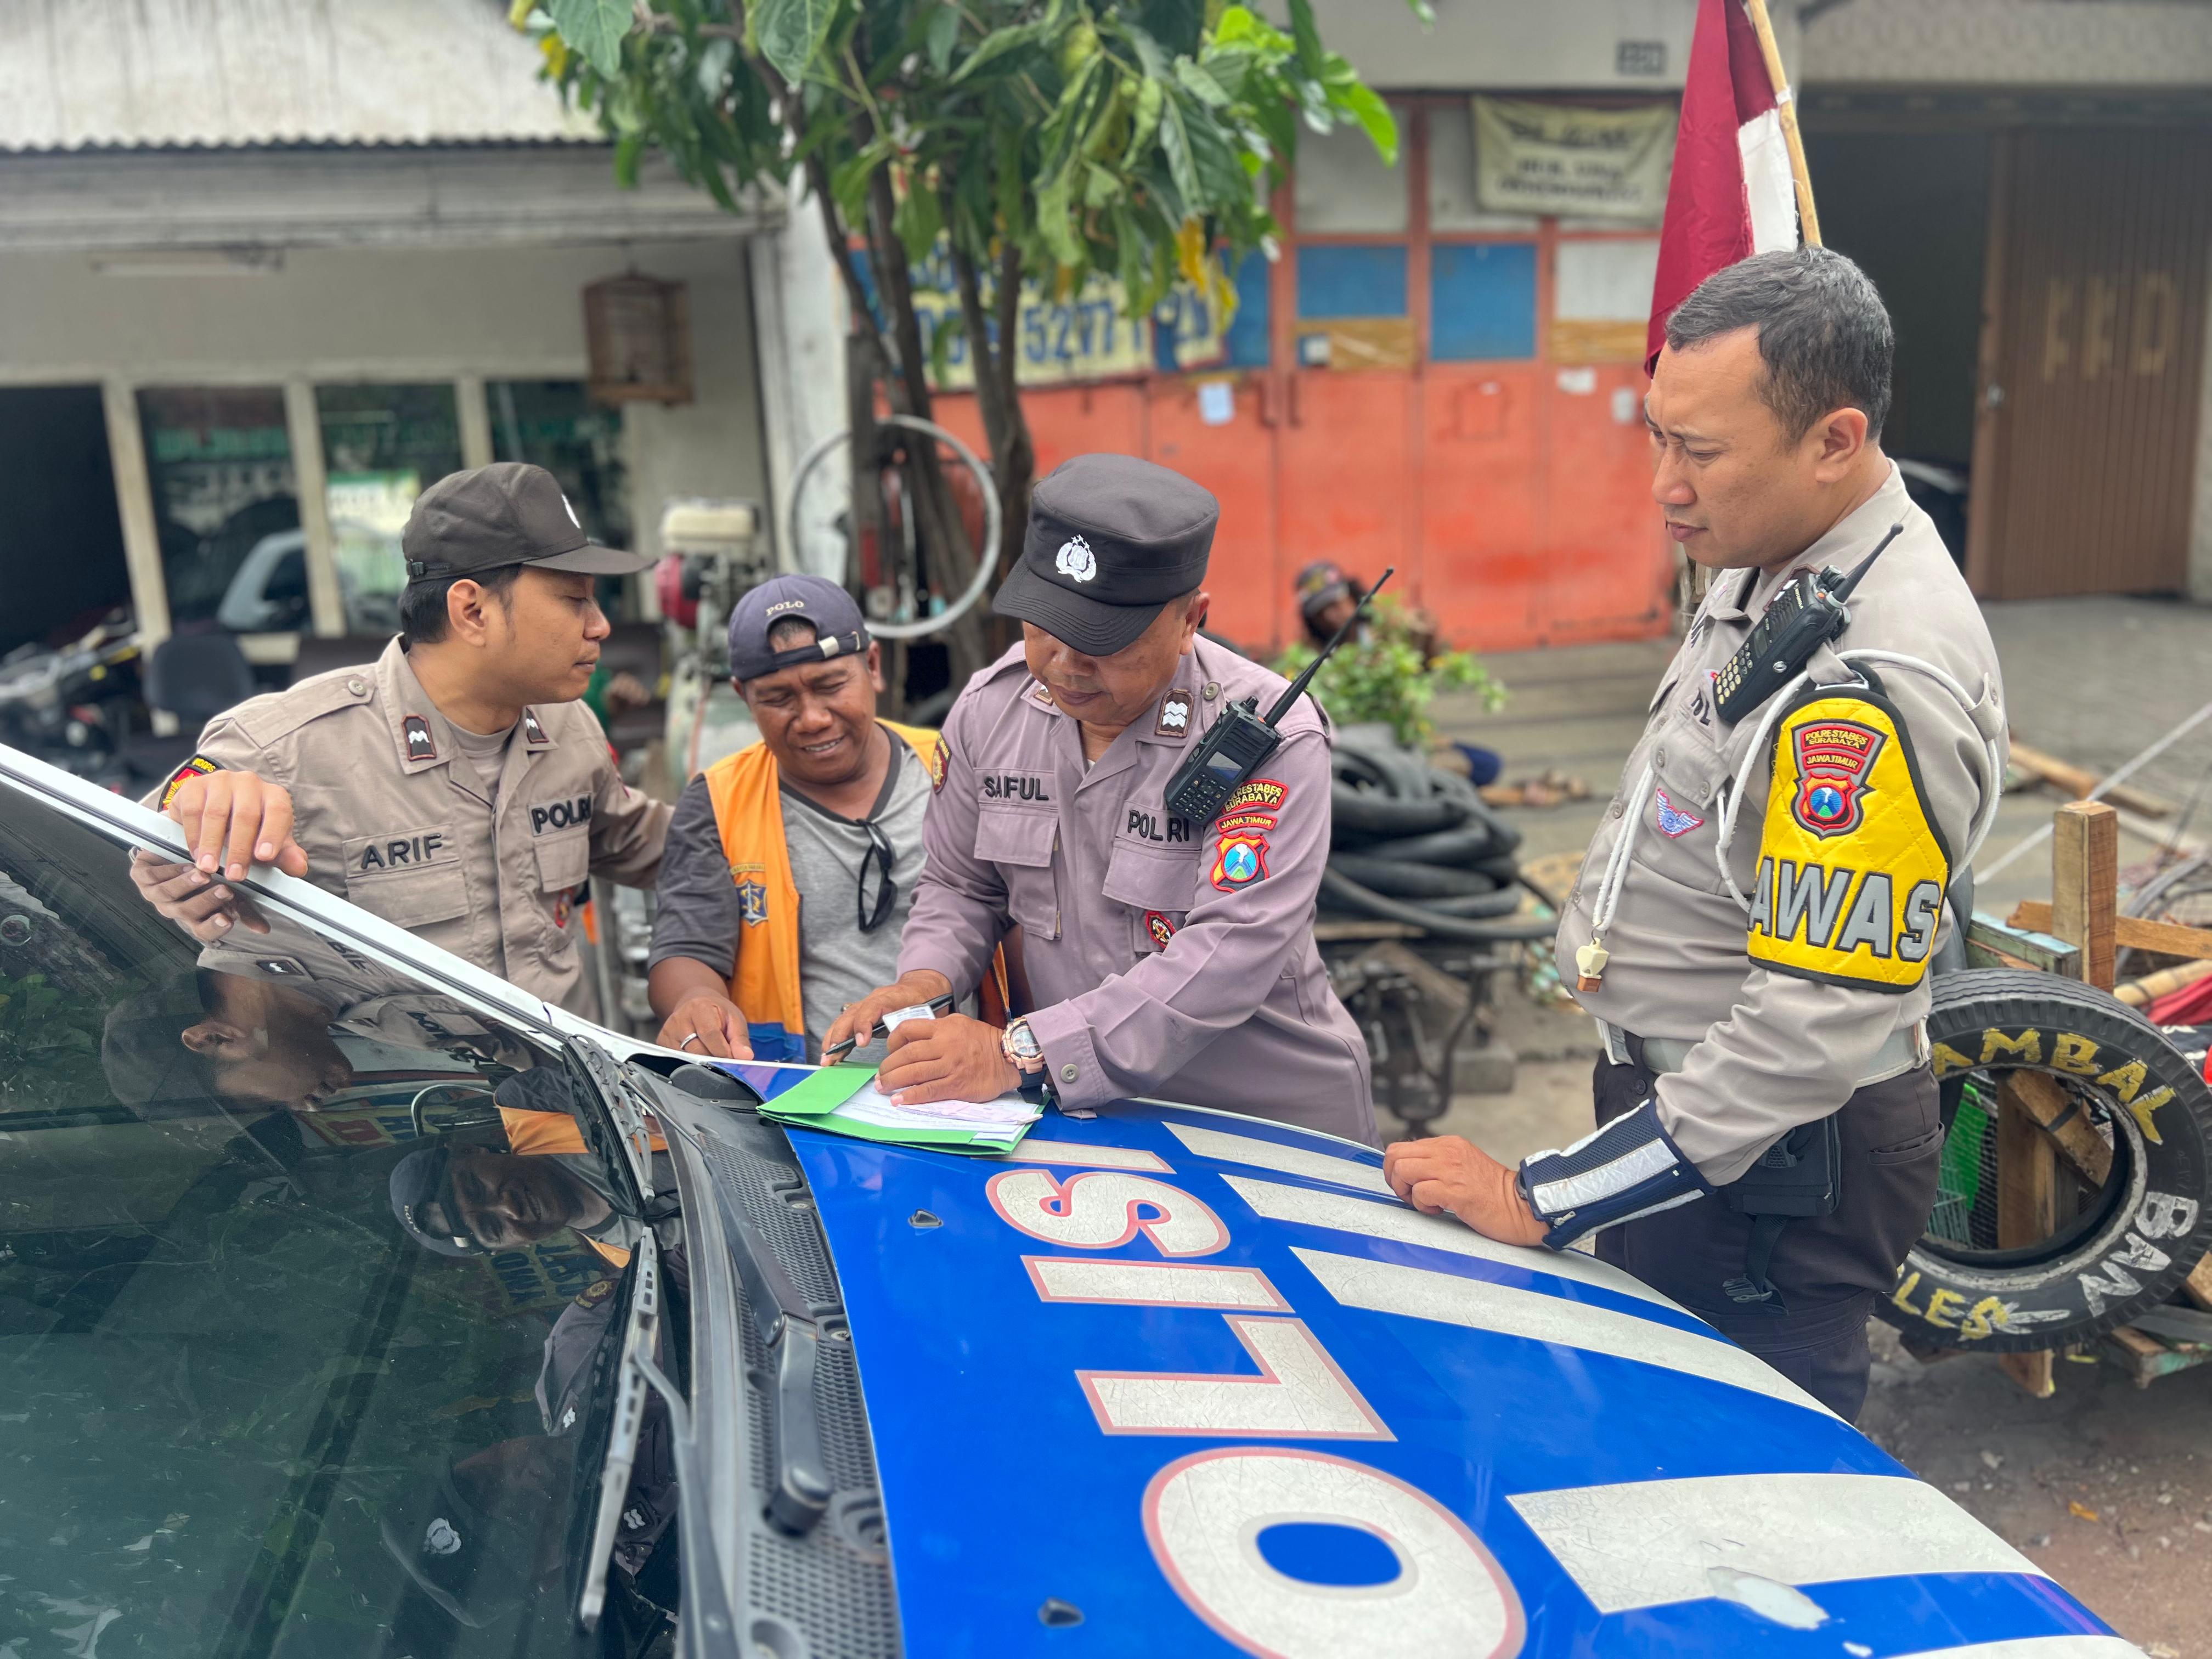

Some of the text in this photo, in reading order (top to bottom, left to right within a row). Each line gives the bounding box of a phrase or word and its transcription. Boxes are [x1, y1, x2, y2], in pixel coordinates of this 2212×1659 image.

[766, 601, 804, 616] POLO
[1805, 729, 1869, 745] POLRESTABES
[1809, 737, 1860, 749] SURABAYA
[1807, 754, 1859, 770] JAWA TIMUR
[984, 775, 1049, 801] SAIFUL
[1127, 809, 1189, 843] POLRI
[1221, 816, 1272, 829] JAWA TIMUR
[362, 833, 442, 870] ARIF
[1747, 855, 1941, 963] AWAS
[2079, 1192, 2199, 1318] BAN
